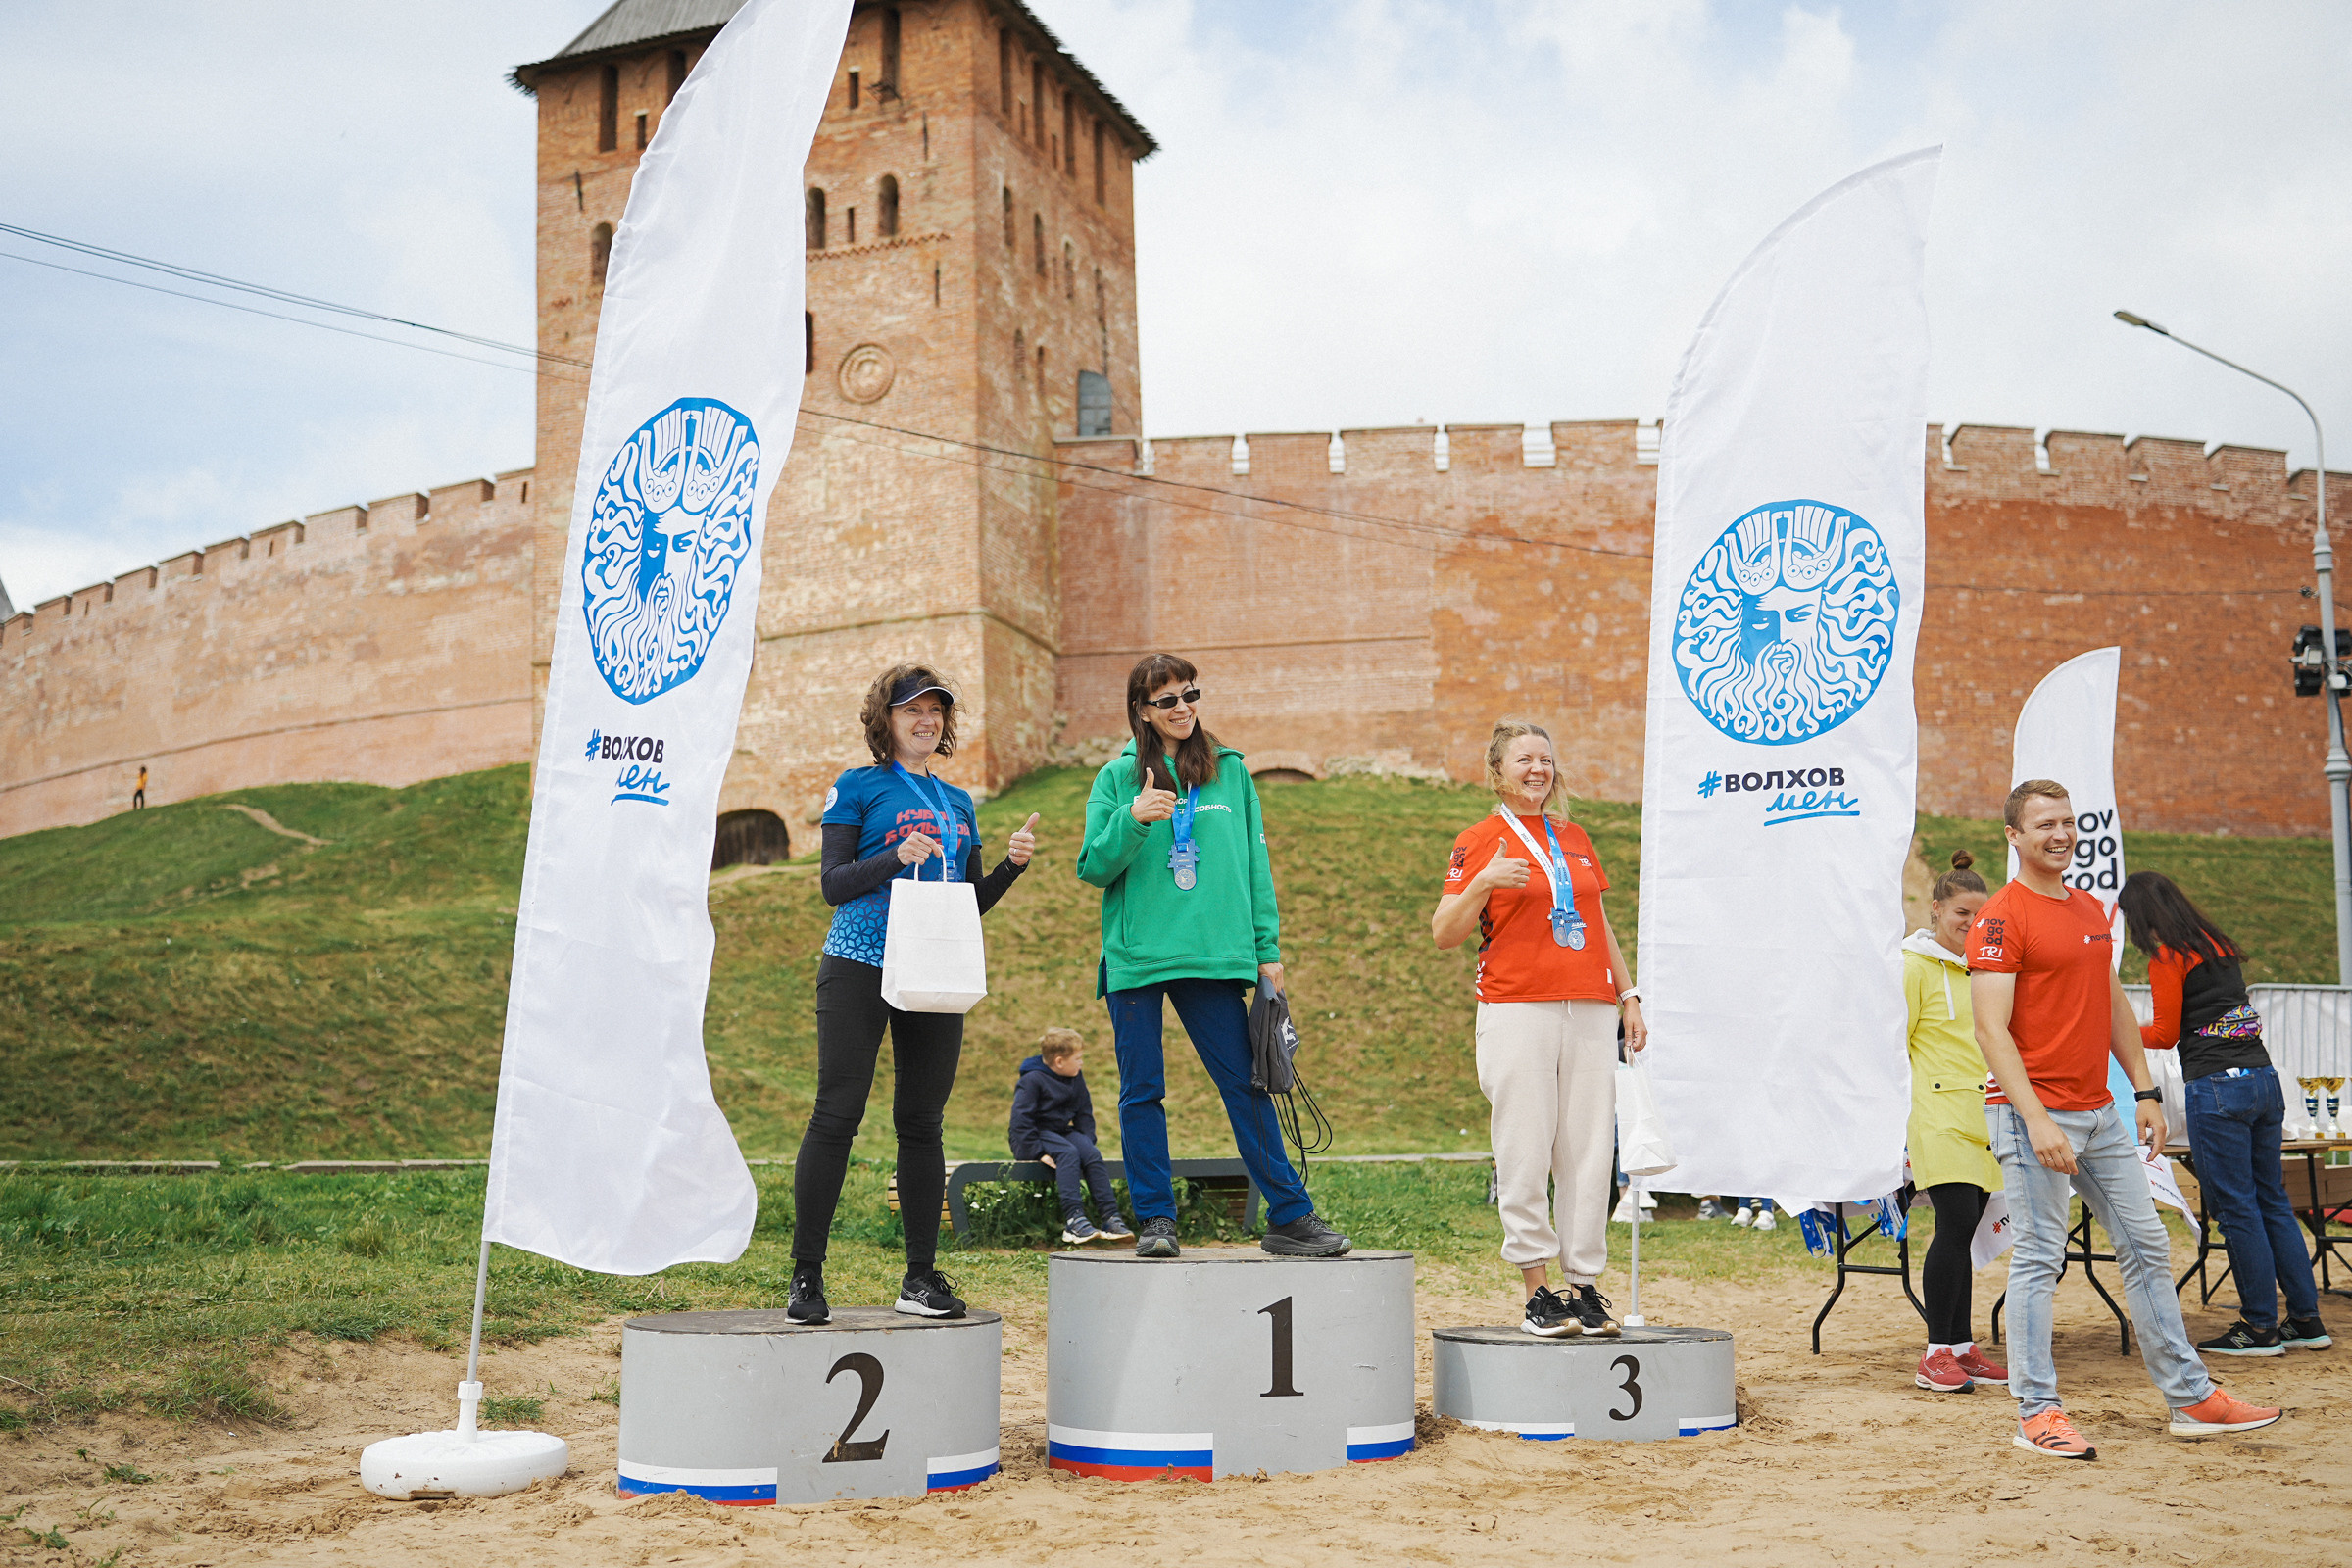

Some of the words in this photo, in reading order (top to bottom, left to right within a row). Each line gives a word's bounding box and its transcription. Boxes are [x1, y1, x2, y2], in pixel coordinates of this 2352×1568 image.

[1697, 767, 1845, 799] #ВОЛХОВ
[2078, 809, 2113, 833] ov
[2074, 836, 2117, 869] go
[1982, 934, 2003, 946] rod
[1987, 926, 2004, 937] go
[1979, 946, 2003, 958] TRI
[1257, 1296, 1304, 1396] 1
[1609, 1355, 1642, 1421] 3
[822, 1351, 890, 1463] 2
